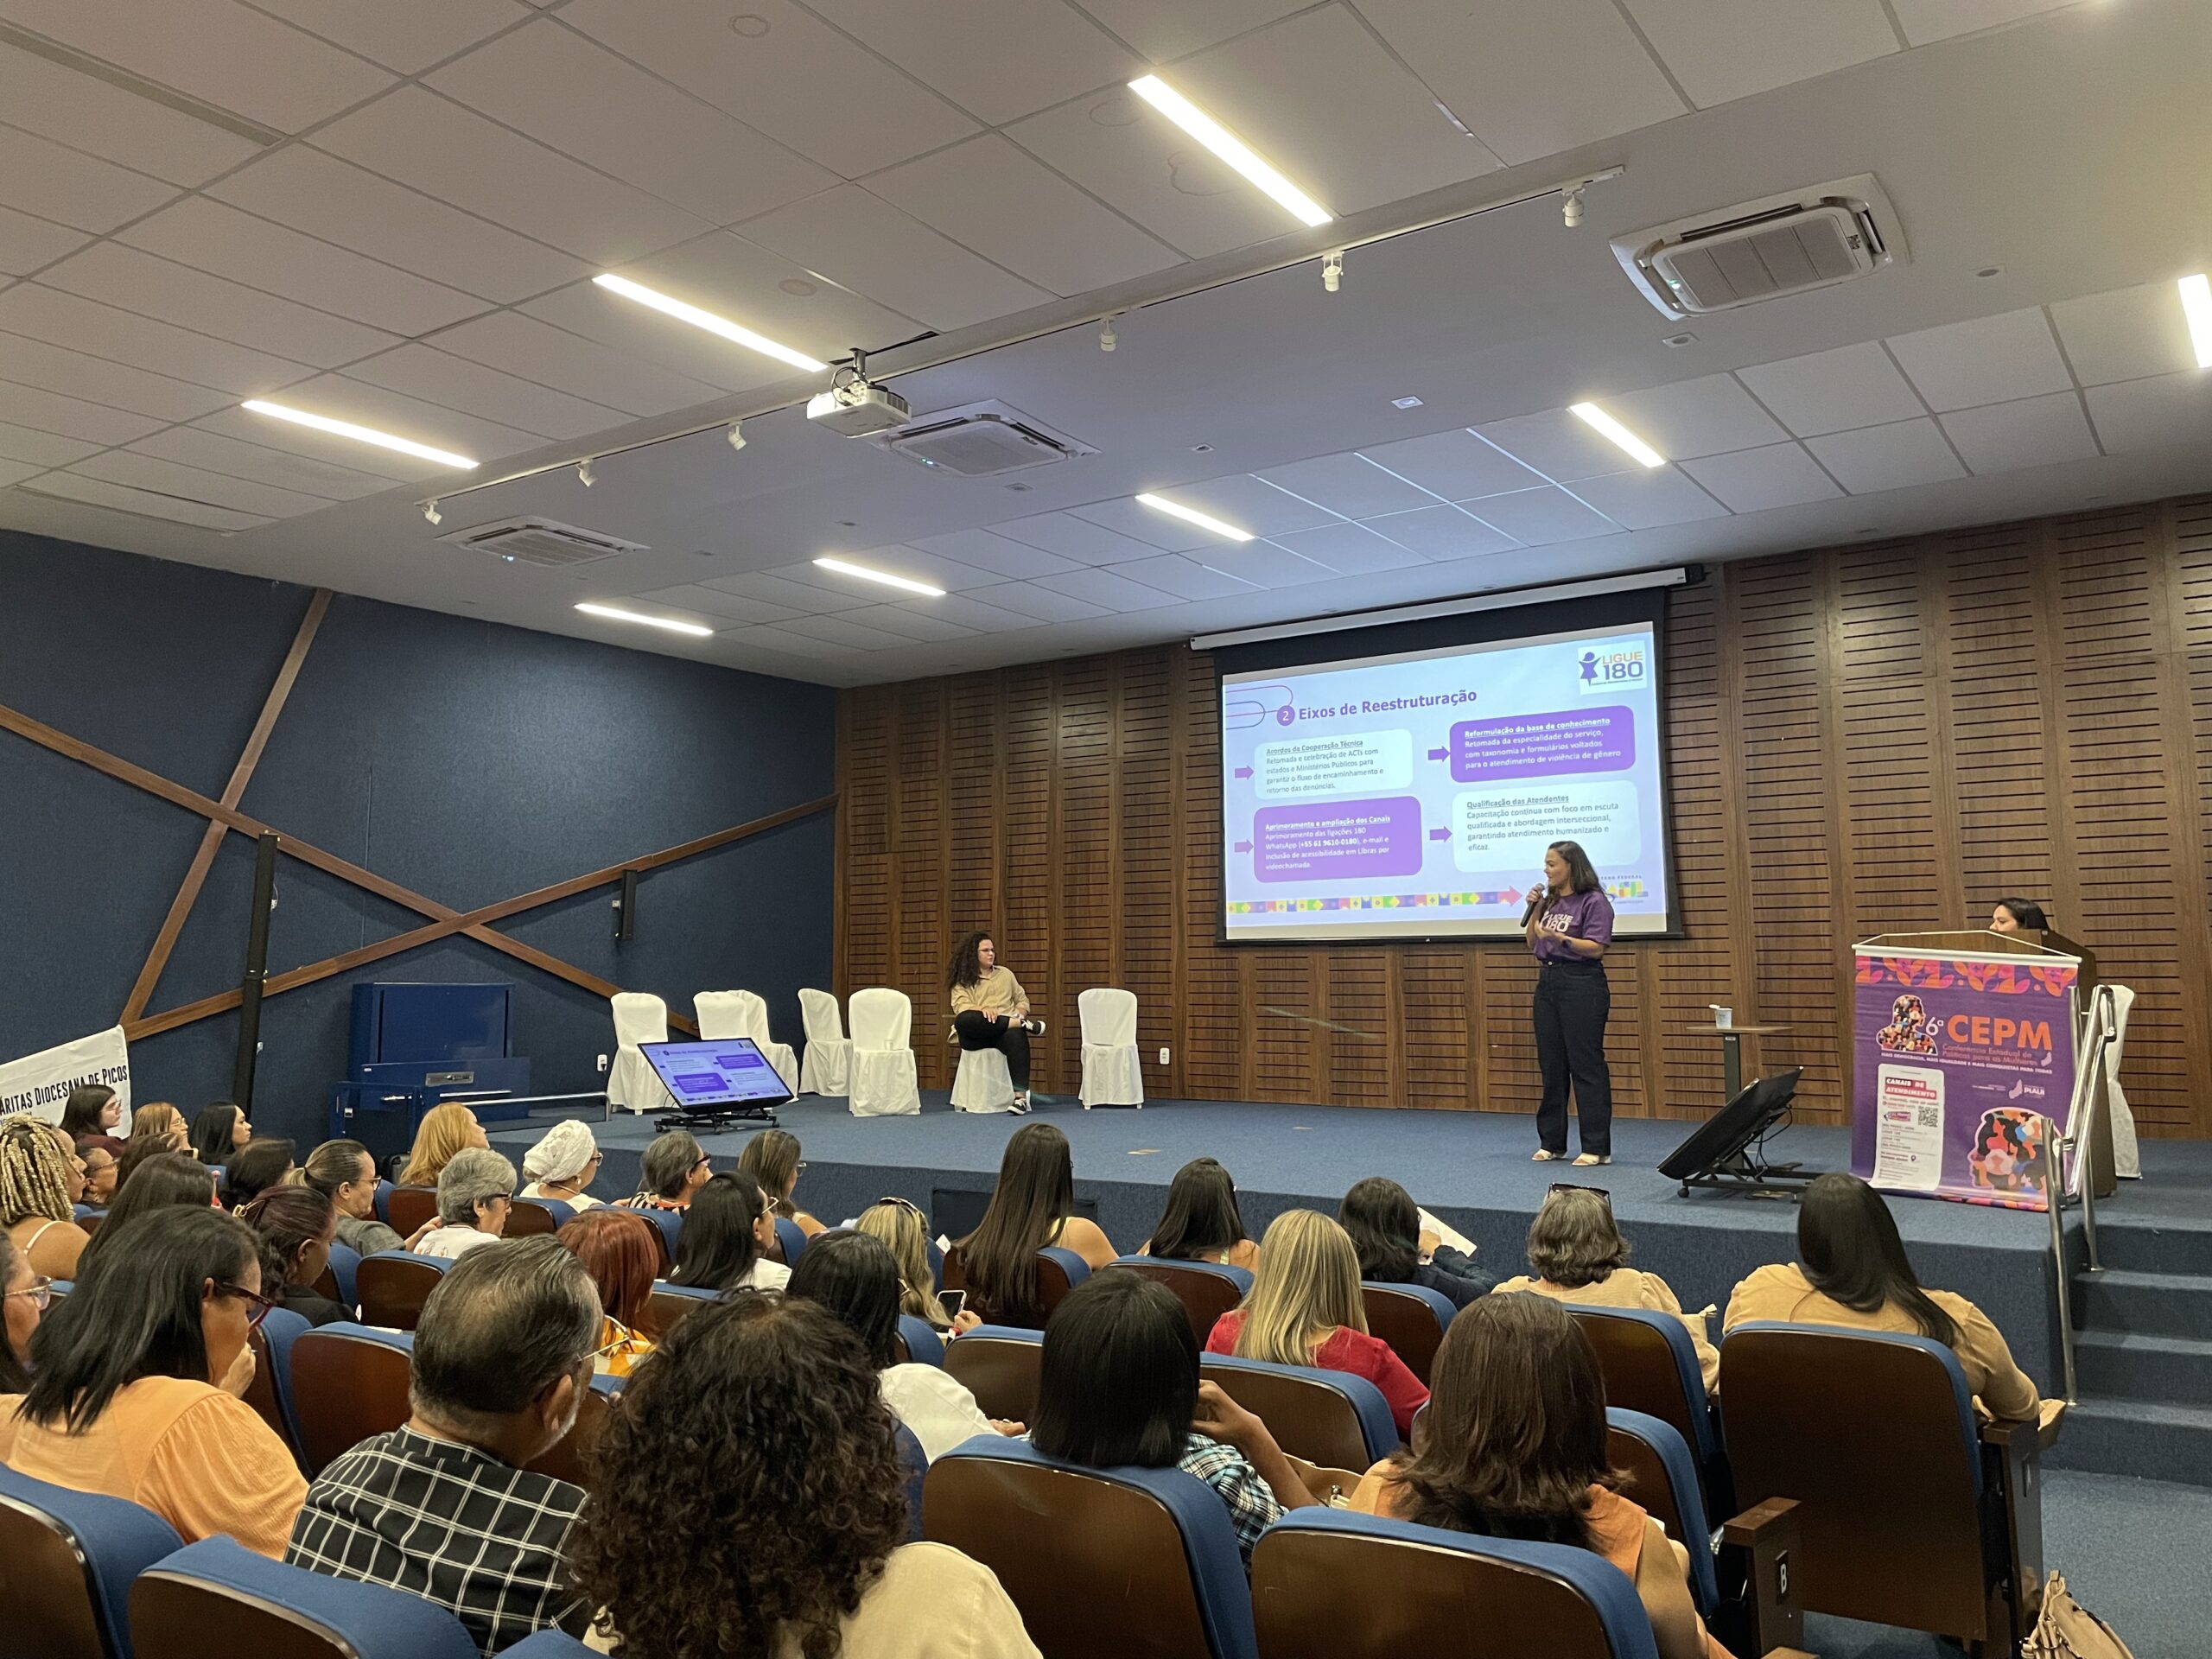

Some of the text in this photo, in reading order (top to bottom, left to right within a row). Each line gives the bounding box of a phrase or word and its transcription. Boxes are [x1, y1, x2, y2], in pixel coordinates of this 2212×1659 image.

[1602, 652, 1643, 664] LIGUE
[1603, 661, 1643, 680] 180
[1282, 690, 1477, 721] 2 Eixos de Reestruturação
[1465, 727, 1514, 738] Reformulação
[1557, 718, 1611, 729] conhecimento
[1465, 739, 1500, 747] Retomada
[1513, 733, 1562, 744] especialidade
[1574, 730, 1604, 739] serviço,
[1301, 742, 1338, 753] Cooperação
[1527, 744, 1568, 753] formulários
[1304, 753, 1337, 761] celebração
[1490, 757, 1535, 766] atendimento
[1548, 753, 1580, 761] violência
[1593, 750, 1621, 760] gênero
[1296, 761, 1331, 772] Ministérios
[1267, 776, 1289, 785] garantir
[1323, 769, 1378, 779] encaminhamento
[1467, 798, 1510, 809] Qualificação
[1527, 795, 1569, 804] Atendentes
[1467, 810, 1510, 819] Capacitação
[1265, 821, 1314, 831] Aprimoramento
[1321, 817, 1354, 827] ampliação
[1467, 820, 1505, 830] qualificada
[1514, 817, 1554, 827] abordagem
[1557, 815, 1611, 824] interseccional,
[1265, 831, 1313, 841] Aprimoramento
[1327, 829, 1352, 837] ligações
[1468, 832, 1506, 842] garantindo
[1508, 829, 1554, 838] atendimento
[1556, 826, 1602, 836] humanizado
[1301, 849, 1344, 858] acessibilidade
[1548, 913, 1573, 922] LIGUE
[1547, 919, 1569, 932] 180
[1948, 1014, 2053, 1051] CEPM
[2003, 1058, 2037, 1066] Mulheres
[35, 1076, 85, 1106] DIOCESANA
[88, 1073, 99, 1085] DE
[102, 1065, 127, 1086] PICOS
[1886, 1087, 1936, 1098] ATENDIMENTO
[1780, 1563, 1787, 1594] B
